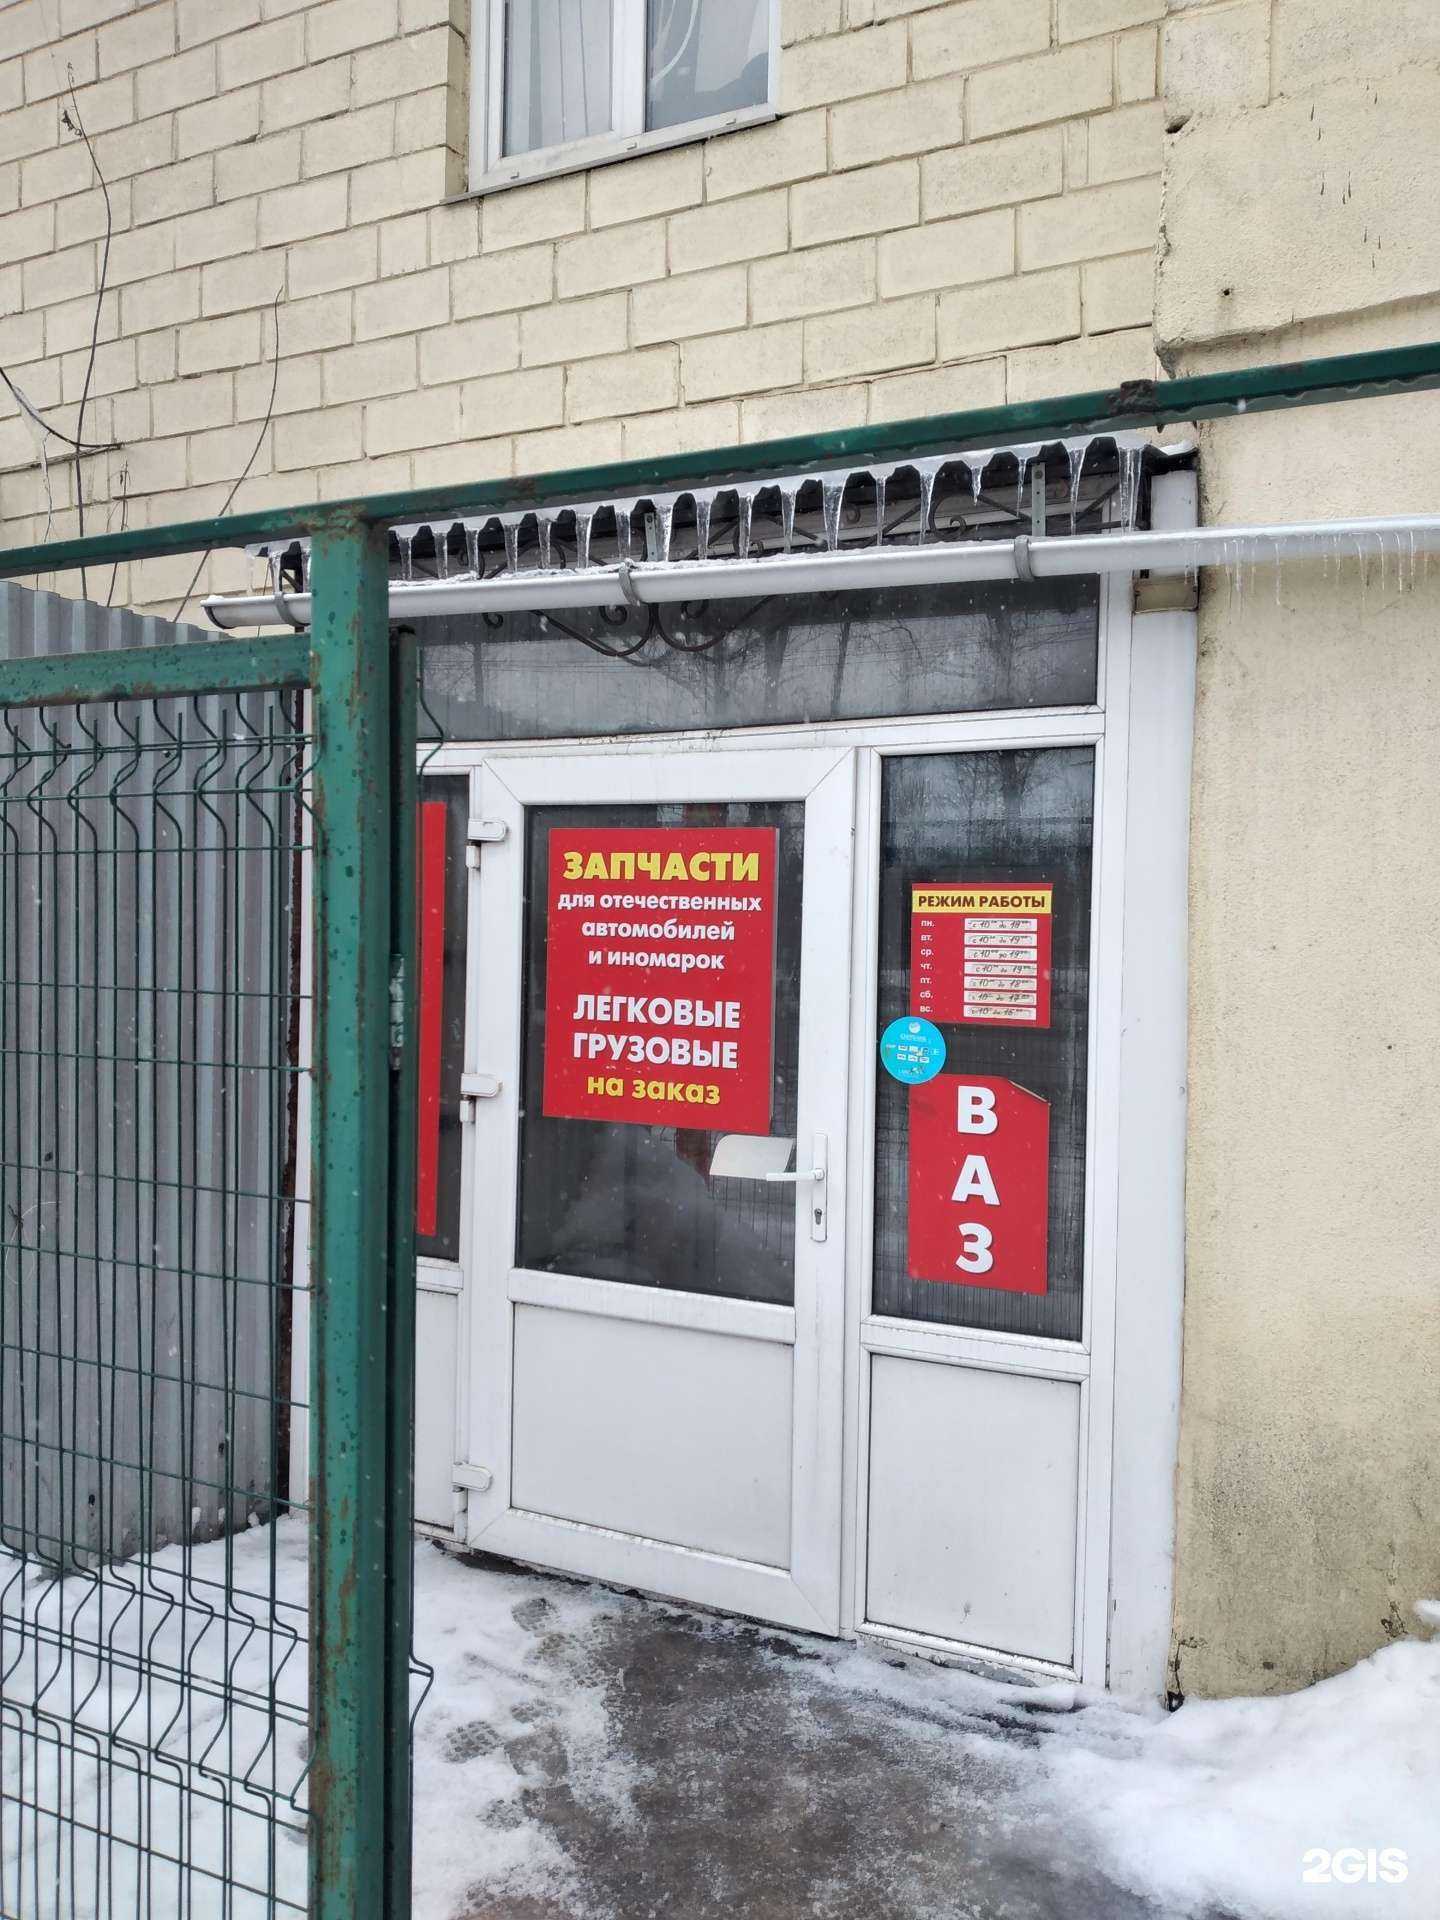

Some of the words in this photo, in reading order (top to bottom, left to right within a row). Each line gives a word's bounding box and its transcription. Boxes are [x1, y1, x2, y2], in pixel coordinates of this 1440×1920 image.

[563, 851, 760, 881] ЗАПЧАСТИ
[557, 893, 595, 910] для
[599, 894, 762, 911] отечественных
[918, 895, 975, 908] РЕЖИМ
[979, 896, 1045, 908] РАБОТЫ
[581, 919, 735, 941] автомобилей
[588, 951, 602, 965] и
[607, 951, 725, 973] иномарок
[572, 994, 741, 1029] ЛЕГКОВЫЕ
[572, 1033, 738, 1069] ГРУЗОВЫЕ
[586, 1076, 624, 1097] на
[631, 1081, 721, 1105] заказ
